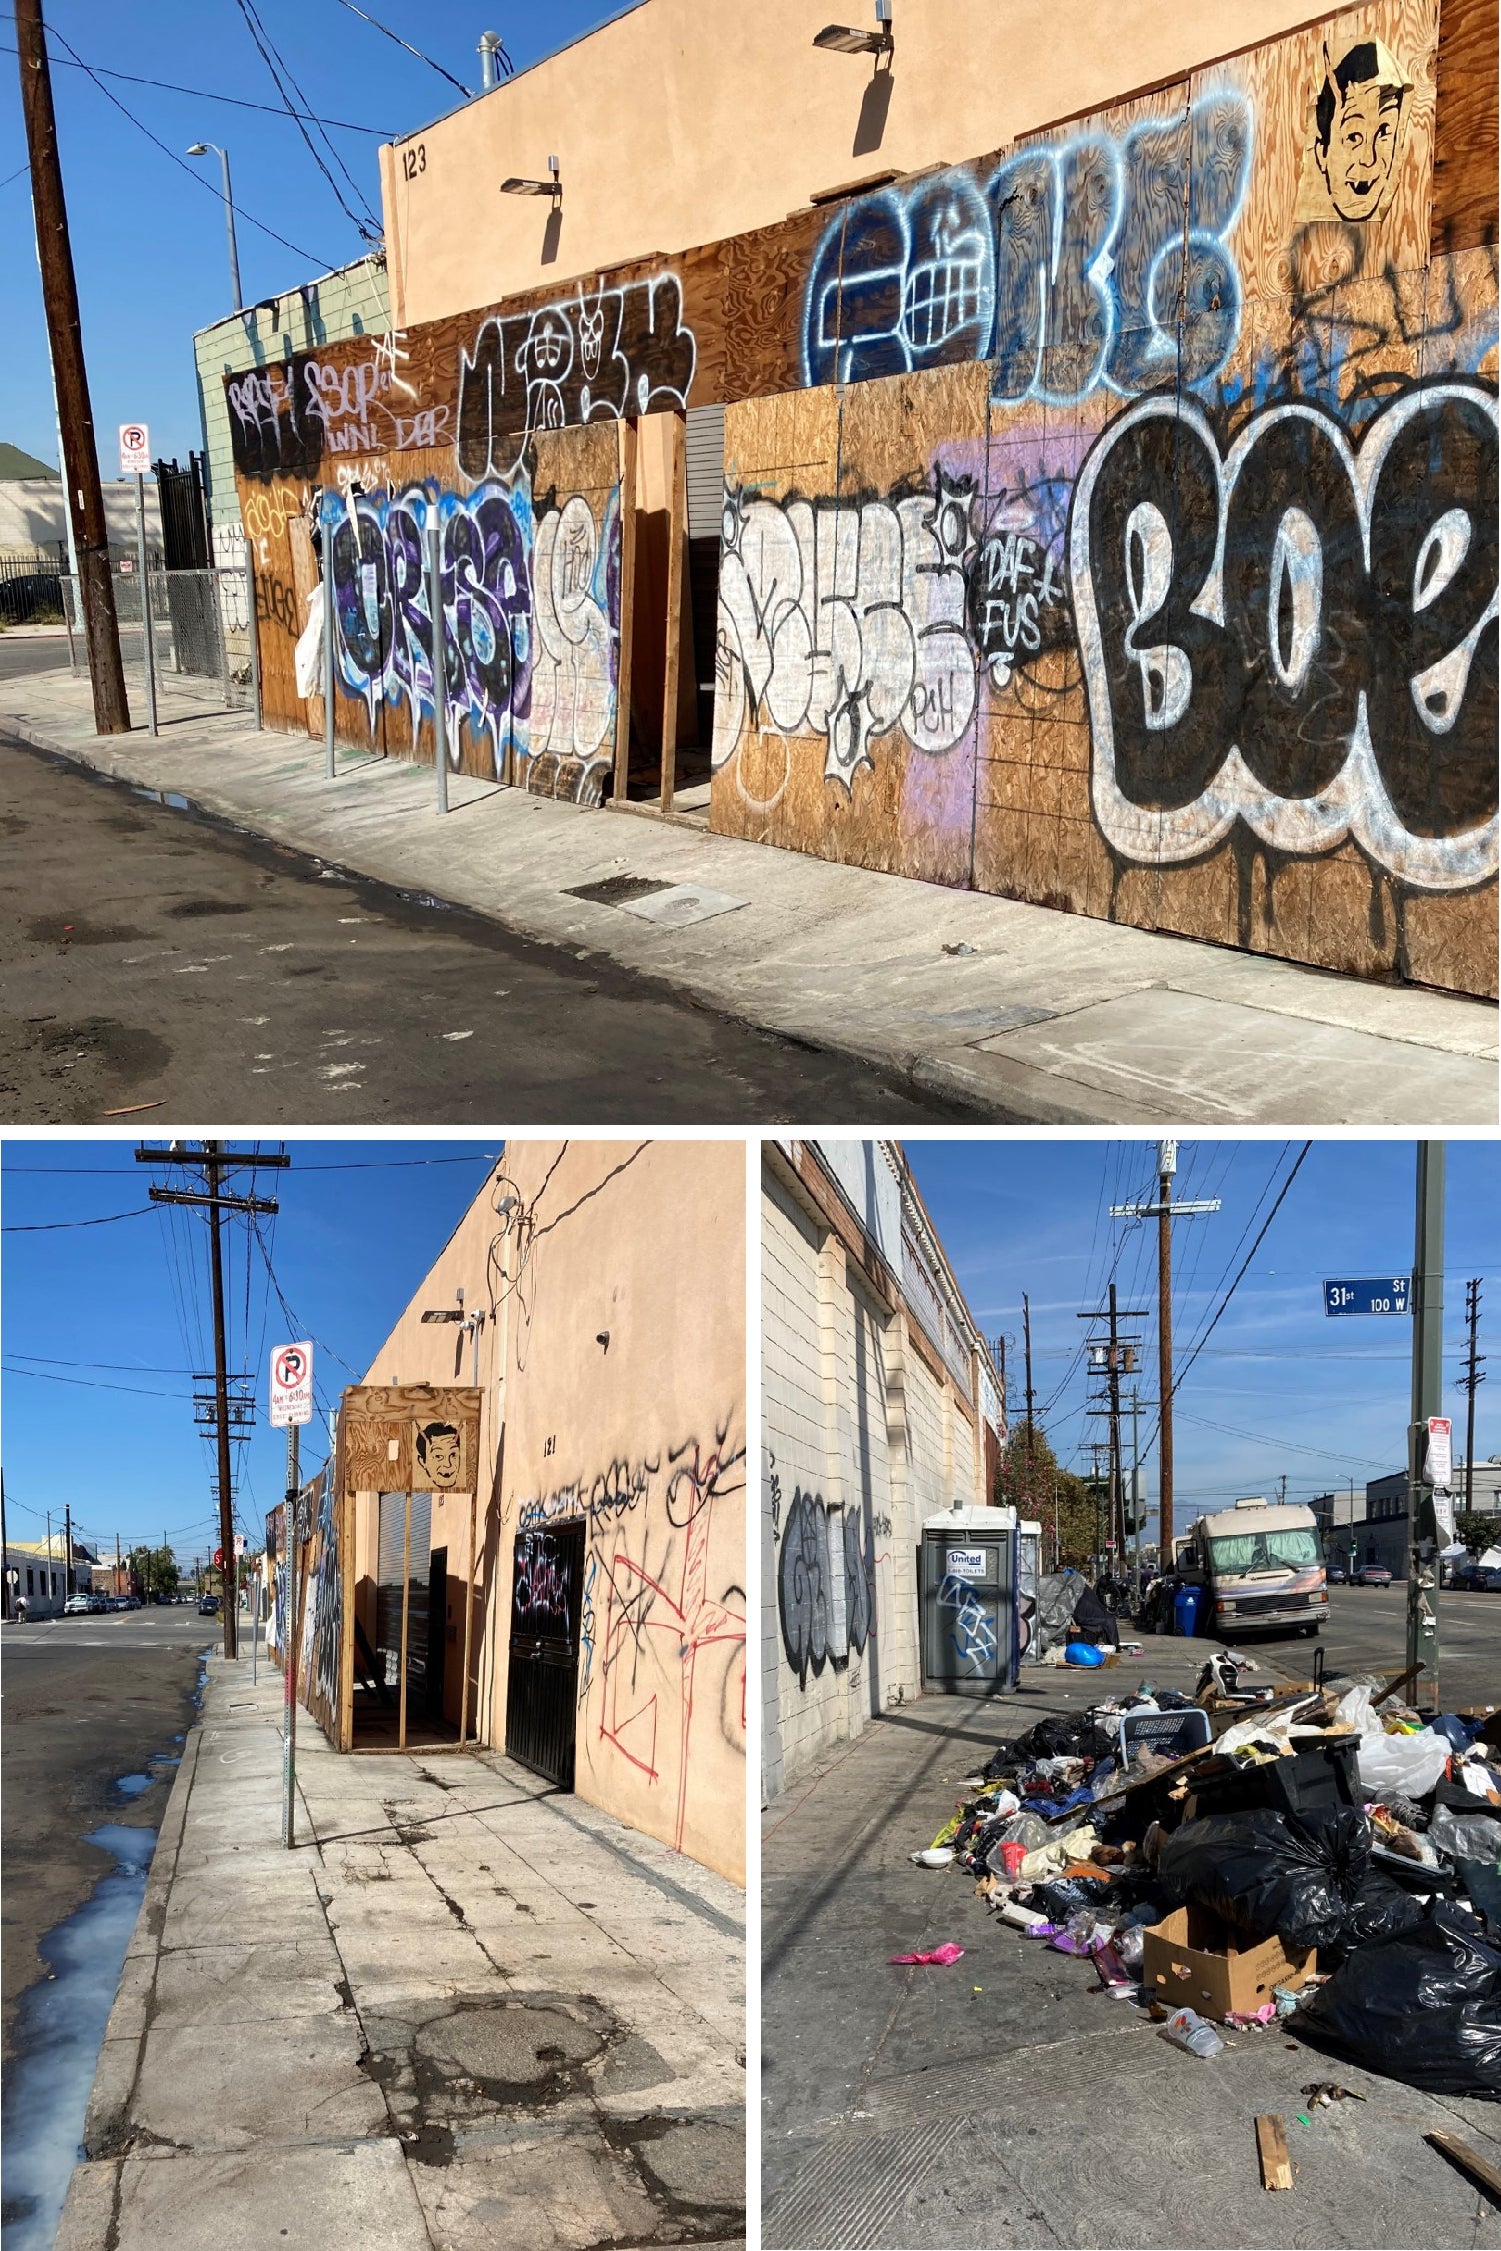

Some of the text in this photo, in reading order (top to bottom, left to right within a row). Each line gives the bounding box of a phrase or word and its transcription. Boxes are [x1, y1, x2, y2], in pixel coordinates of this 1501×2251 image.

[402, 144, 426, 182] 123
[1329, 1279, 1406, 1306] 31st St
[1371, 1297, 1405, 1312] 100 W
[951, 1554, 982, 1564] United
